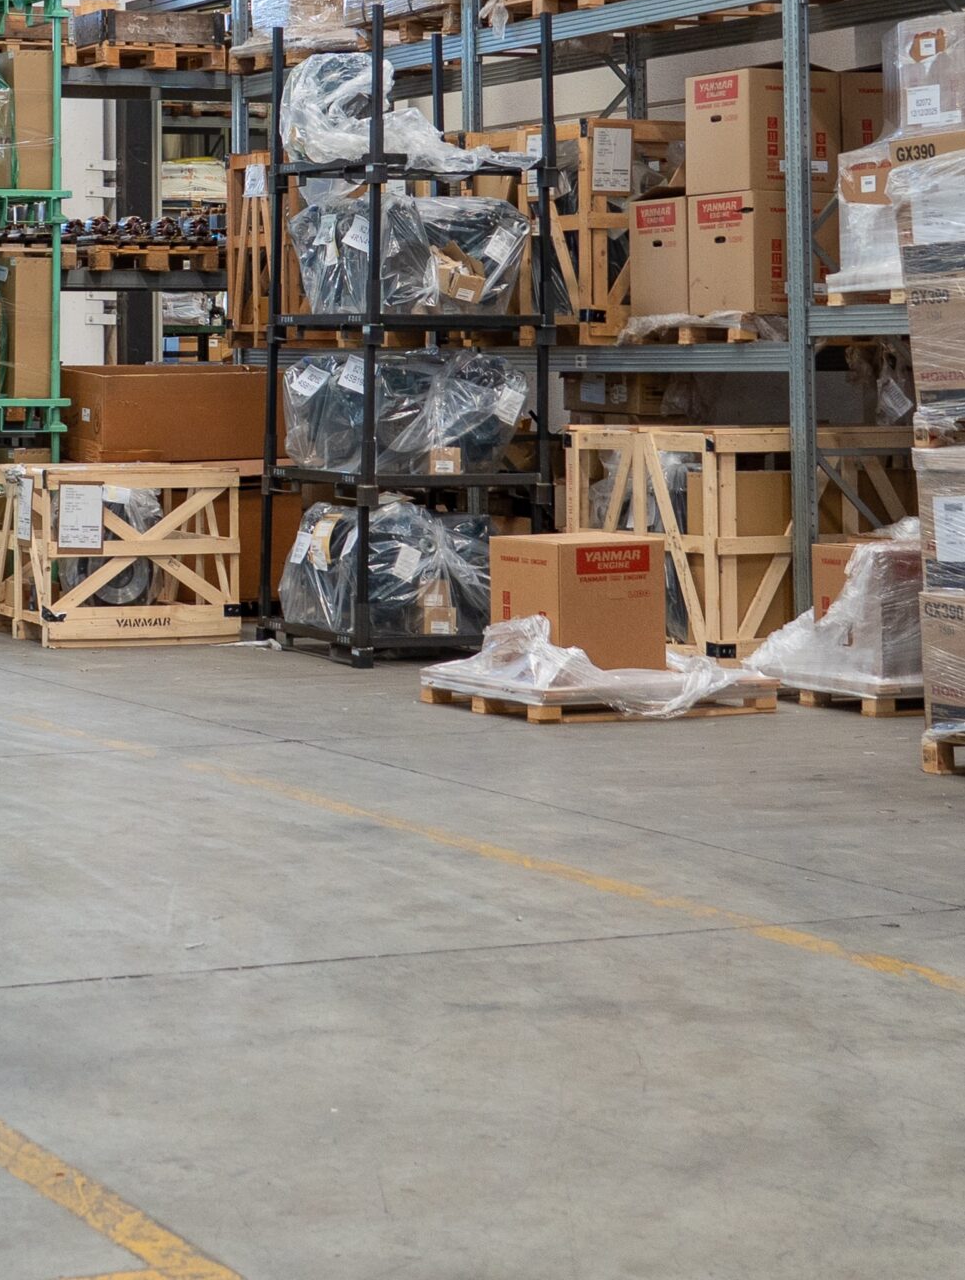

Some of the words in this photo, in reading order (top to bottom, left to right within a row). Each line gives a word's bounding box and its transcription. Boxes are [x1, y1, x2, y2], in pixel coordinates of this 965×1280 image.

[699, 80, 733, 93] YANMAR
[896, 143, 936, 162] GX390
[702, 200, 737, 211] YANMAR
[585, 550, 641, 561] YANMAR
[597, 561, 630, 570] ENGINE
[924, 602, 964, 619] GX390
[116, 618, 171, 628] YANMAR
